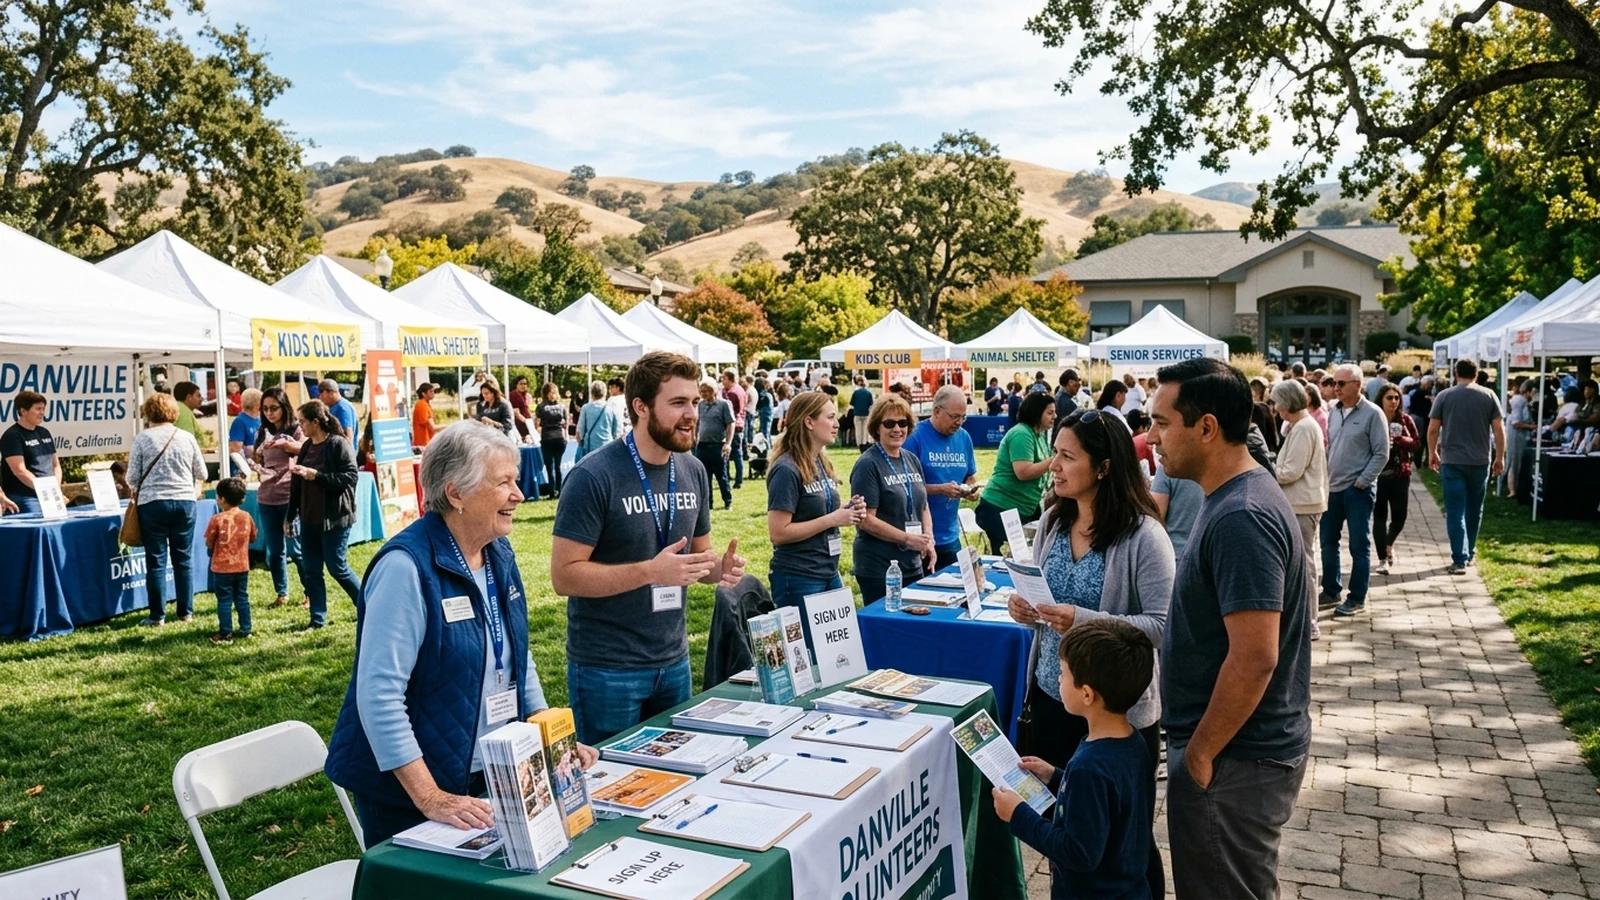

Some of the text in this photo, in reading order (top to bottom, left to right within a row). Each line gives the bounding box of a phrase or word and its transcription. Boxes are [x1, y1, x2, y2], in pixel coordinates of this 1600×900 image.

[278, 332, 345, 358] KIDS CLUB
[403, 335, 479, 356] ANIMAL SHELTER
[1110, 348, 1203, 361] SENIOR SERVICES
[855, 353, 911, 365] KIDS CLUB
[970, 351, 1056, 363] ANIMAL SHELTER
[0, 362, 127, 394] DANVILLE
[75, 433, 123, 448] California
[813, 605, 851, 625] SIGN UP
[825, 627, 850, 644] HERE
[839, 768, 929, 883] DANVILLE
[608, 850, 662, 885] SIGN UP
[643, 861, 685, 885] HERE
